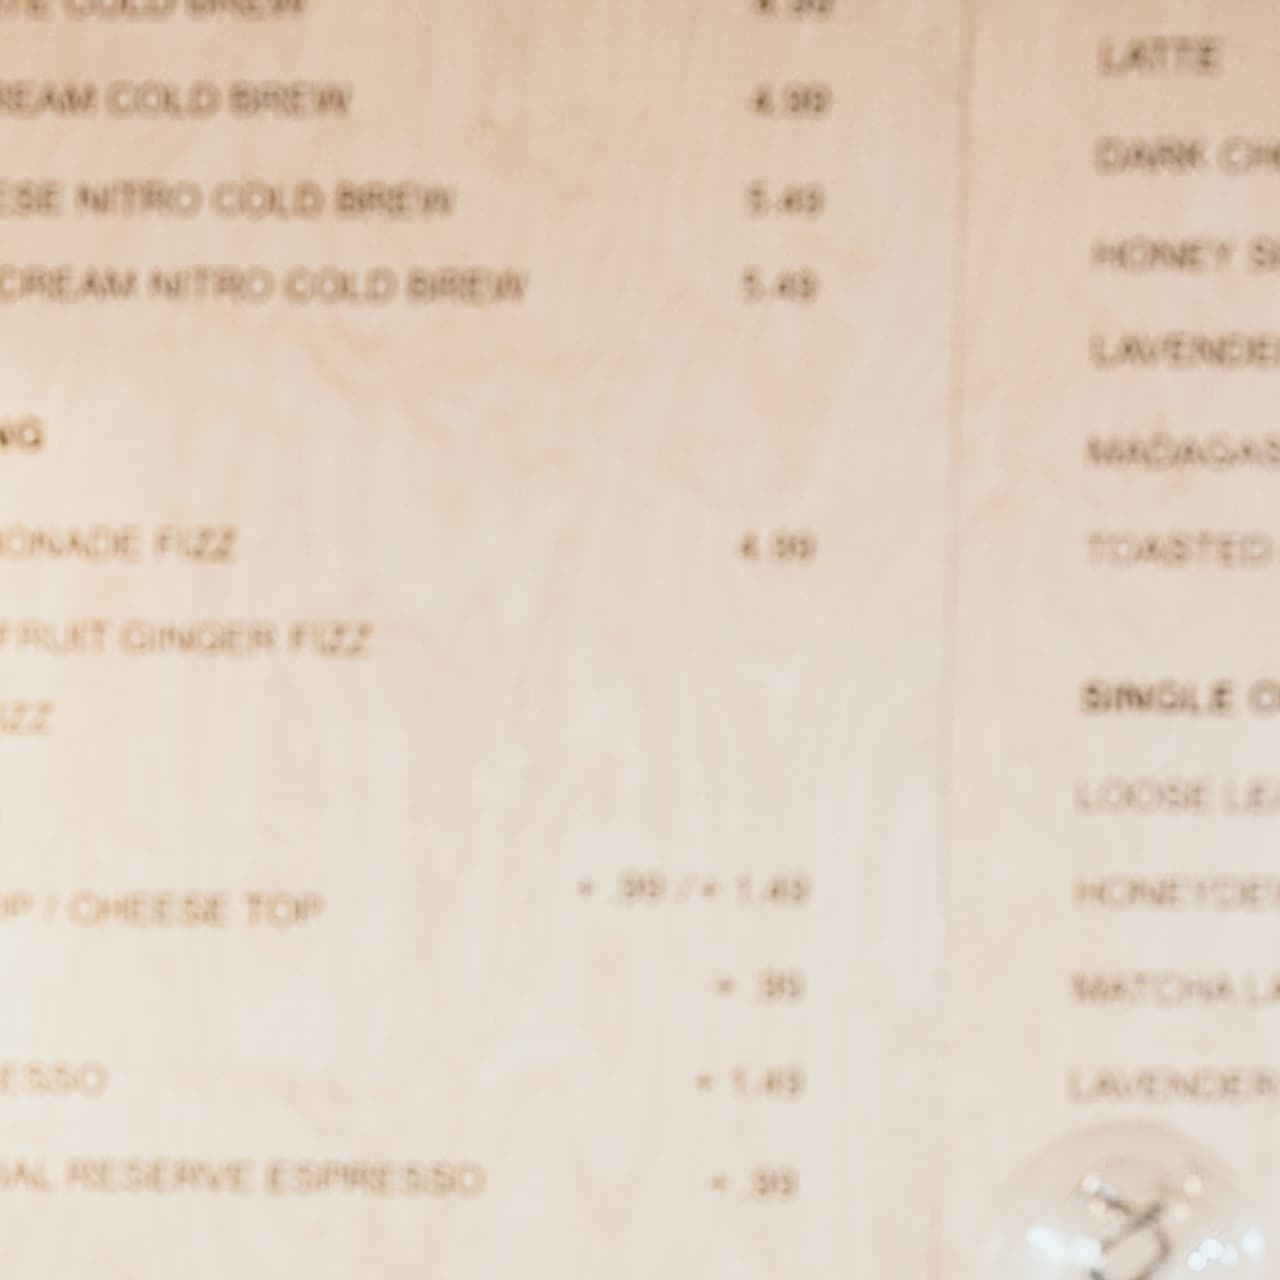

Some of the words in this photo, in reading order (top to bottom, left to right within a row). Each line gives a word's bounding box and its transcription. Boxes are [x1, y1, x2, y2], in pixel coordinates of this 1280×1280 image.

[1096, 36, 1223, 76] LATTE
[105, 79, 220, 117] COLD
[228, 80, 350, 118] BREW
[74, 180, 202, 218] NITRO
[211, 181, 323, 219] COLD
[336, 181, 454, 218] BREW
[148, 266, 274, 300] NITRO
[284, 267, 398, 301] COLD
[406, 267, 527, 302] BREW
[155, 525, 239, 562] FIZZ
[119, 620, 276, 656] GINGER
[288, 621, 373, 657] FIZZ
[1081, 679, 1236, 719] SINGLE
[67, 891, 228, 927] CHEESE
[244, 892, 324, 927] TOP
[67, 1157, 245, 1194] RESERVE
[266, 1160, 486, 1196] ESPRESSO
